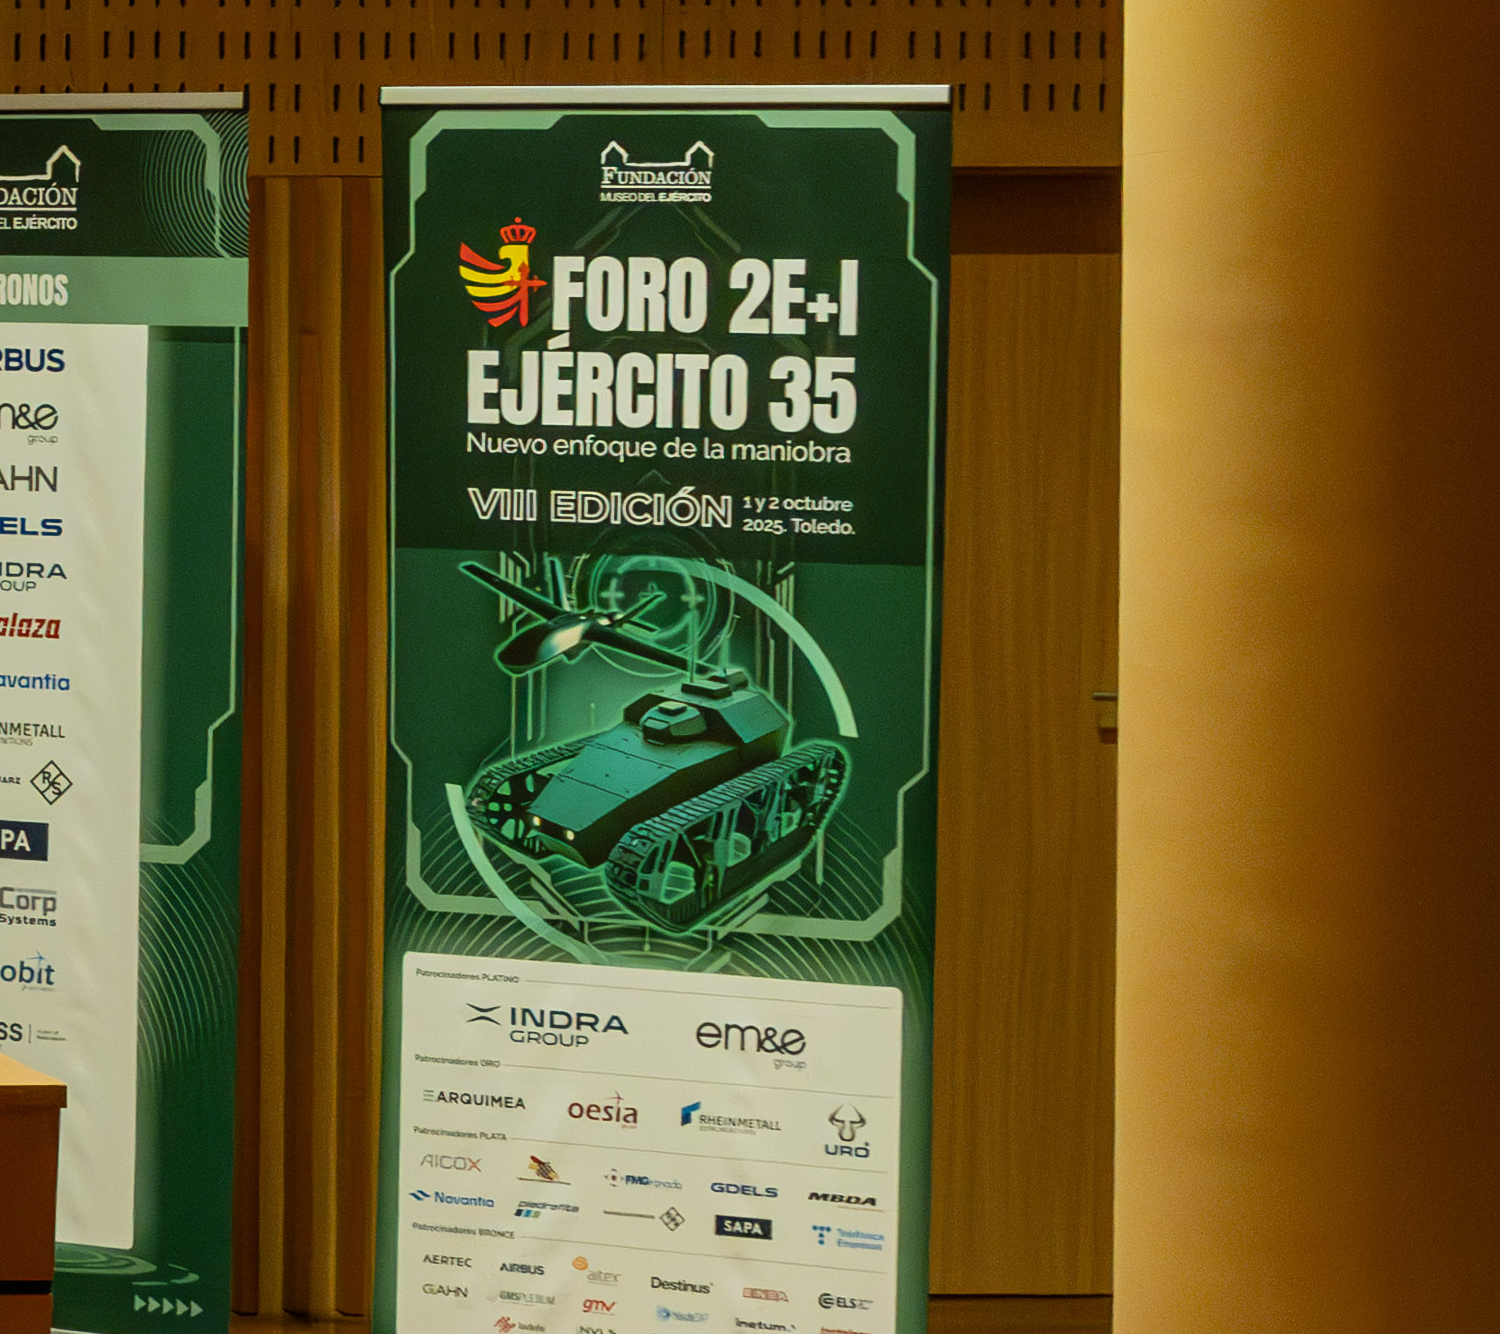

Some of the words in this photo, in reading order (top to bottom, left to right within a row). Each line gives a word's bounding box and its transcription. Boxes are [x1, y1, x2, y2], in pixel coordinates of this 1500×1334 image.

[600, 165, 712, 186] FUNDACIÓN
[12, 214, 78, 231] EJÉRCITO
[552, 256, 708, 333] FORO
[728, 258, 859, 336] 2E+I
[466, 331, 749, 431] EJÉRCITO
[768, 356, 857, 434] 35
[466, 433, 547, 455] Nuevo
[553, 436, 657, 463] enfoque
[663, 437, 698, 459] de
[703, 437, 725, 460] la
[731, 440, 852, 464] maniobra
[467, 488, 537, 522] VIII
[549, 486, 733, 528] EDICIÓN
[743, 496, 752, 510] 1
[754, 499, 766, 514] y
[768, 497, 779, 511] 2
[782, 496, 854, 513] octubre
[742, 518, 788, 534] 2025.
[790, 518, 856, 535] Toledo.
[510, 1007, 629, 1035] INDRA
[510, 1030, 589, 1048] GROUP
[696, 1021, 806, 1056] em&e
[436, 1090, 526, 1110] ARQUIMEA
[568, 1098, 638, 1125] oesia
[699, 1114, 782, 1132] RHEINMETALL
[824, 1143, 870, 1159] URO
[434, 1191, 495, 1208] Navantia
[710, 1183, 779, 1198] GDELS
[808, 1192, 877, 1207] MBDA
[723, 1220, 764, 1236] SAPA
[500, 1263, 545, 1276] AIRBUS
[650, 1276, 711, 1295] Destinus
